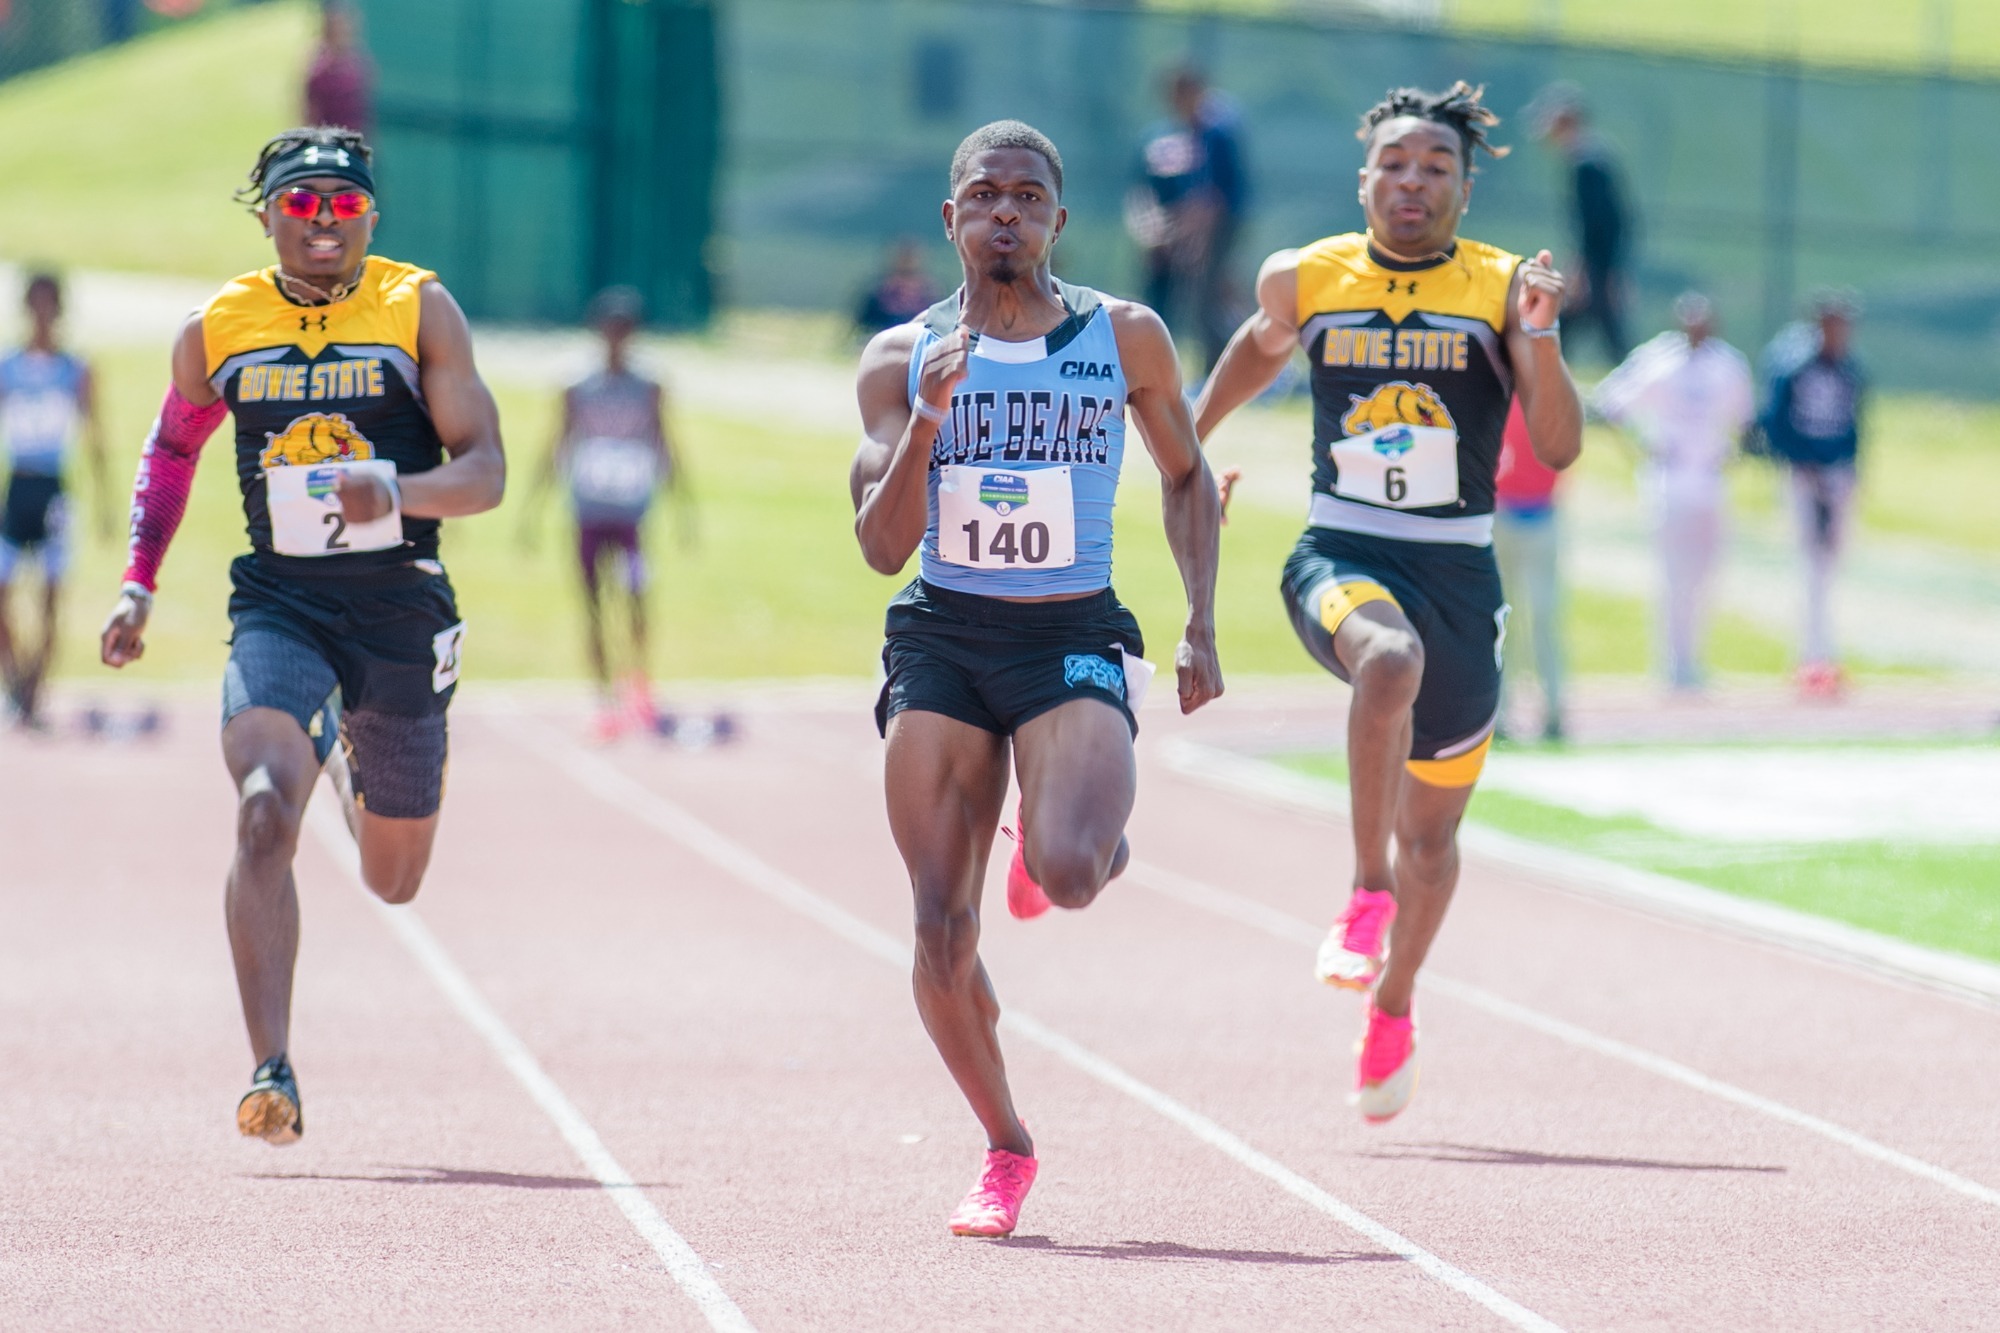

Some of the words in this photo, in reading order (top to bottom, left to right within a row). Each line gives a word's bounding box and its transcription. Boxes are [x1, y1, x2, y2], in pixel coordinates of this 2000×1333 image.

[1323, 327, 1392, 369] BOWIE
[1395, 328, 1468, 371] STATE
[238, 363, 308, 402] BOWIE
[309, 357, 385, 400] STATE
[1060, 361, 1115, 382] CIAA
[929, 391, 997, 471] LUE
[1001, 390, 1112, 466] BEARS
[1385, 467, 1407, 502] 6
[323, 512, 349, 550] 2
[962, 519, 1050, 564] 140
